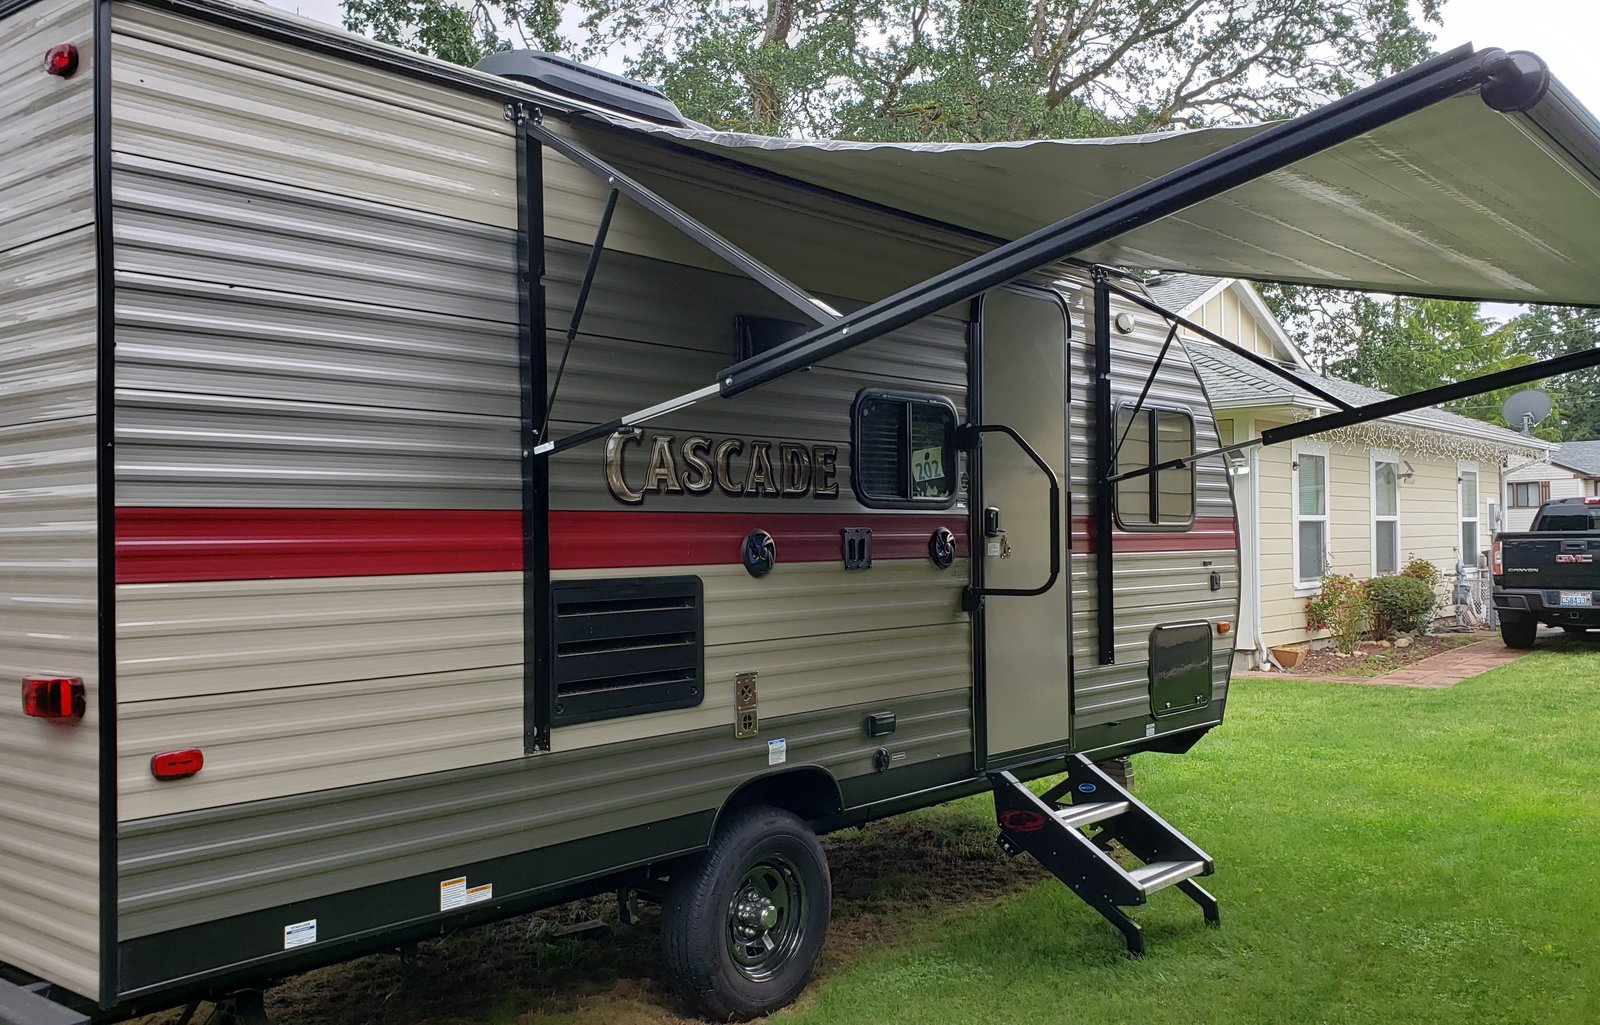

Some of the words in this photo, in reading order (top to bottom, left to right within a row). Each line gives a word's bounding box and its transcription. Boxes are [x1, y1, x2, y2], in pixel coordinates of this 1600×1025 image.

[603, 427, 840, 504] CASCADE
[914, 459, 940, 482] 202
[1556, 554, 1593, 563] GMC
